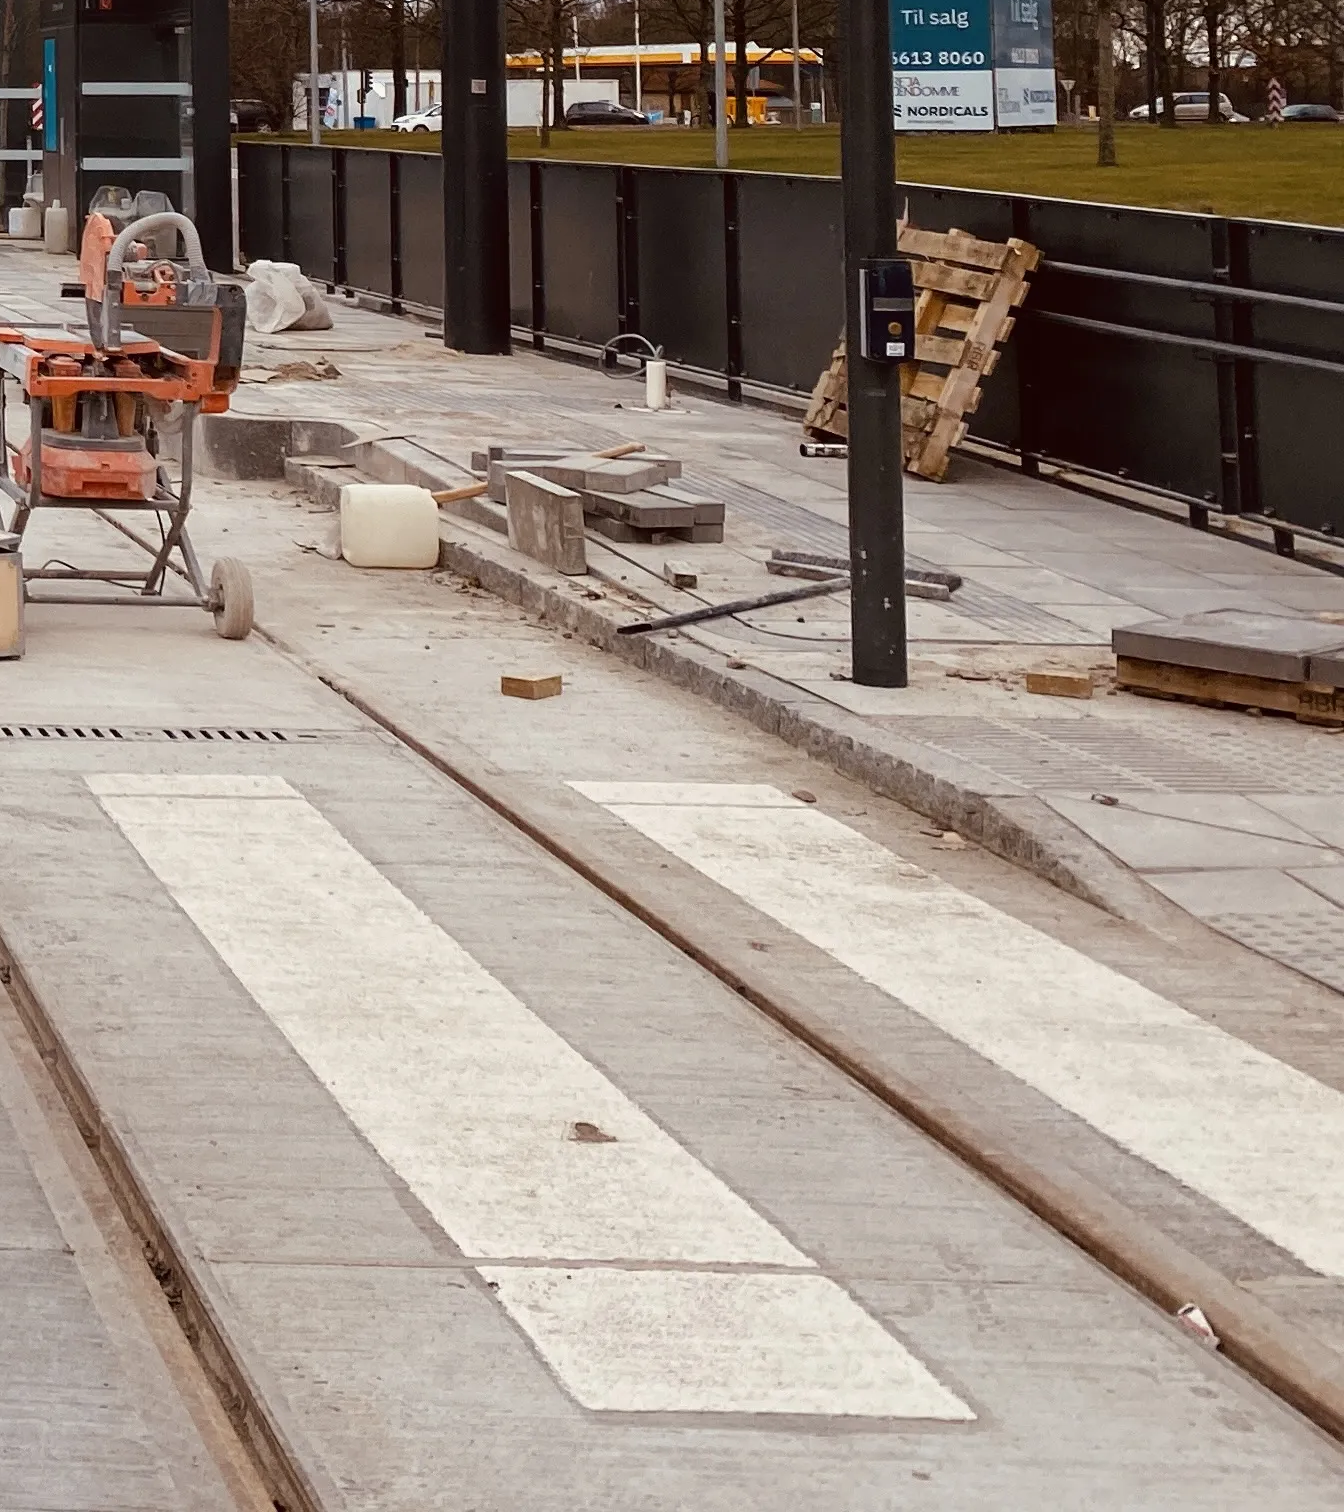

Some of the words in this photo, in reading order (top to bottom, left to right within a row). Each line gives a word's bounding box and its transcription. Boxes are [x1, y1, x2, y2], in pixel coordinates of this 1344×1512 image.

[900, 9, 924, 25] Til
[929, 8, 969, 28] salg
[938, 51, 985, 65] 8060
[908, 106, 989, 116] NORDICALS
